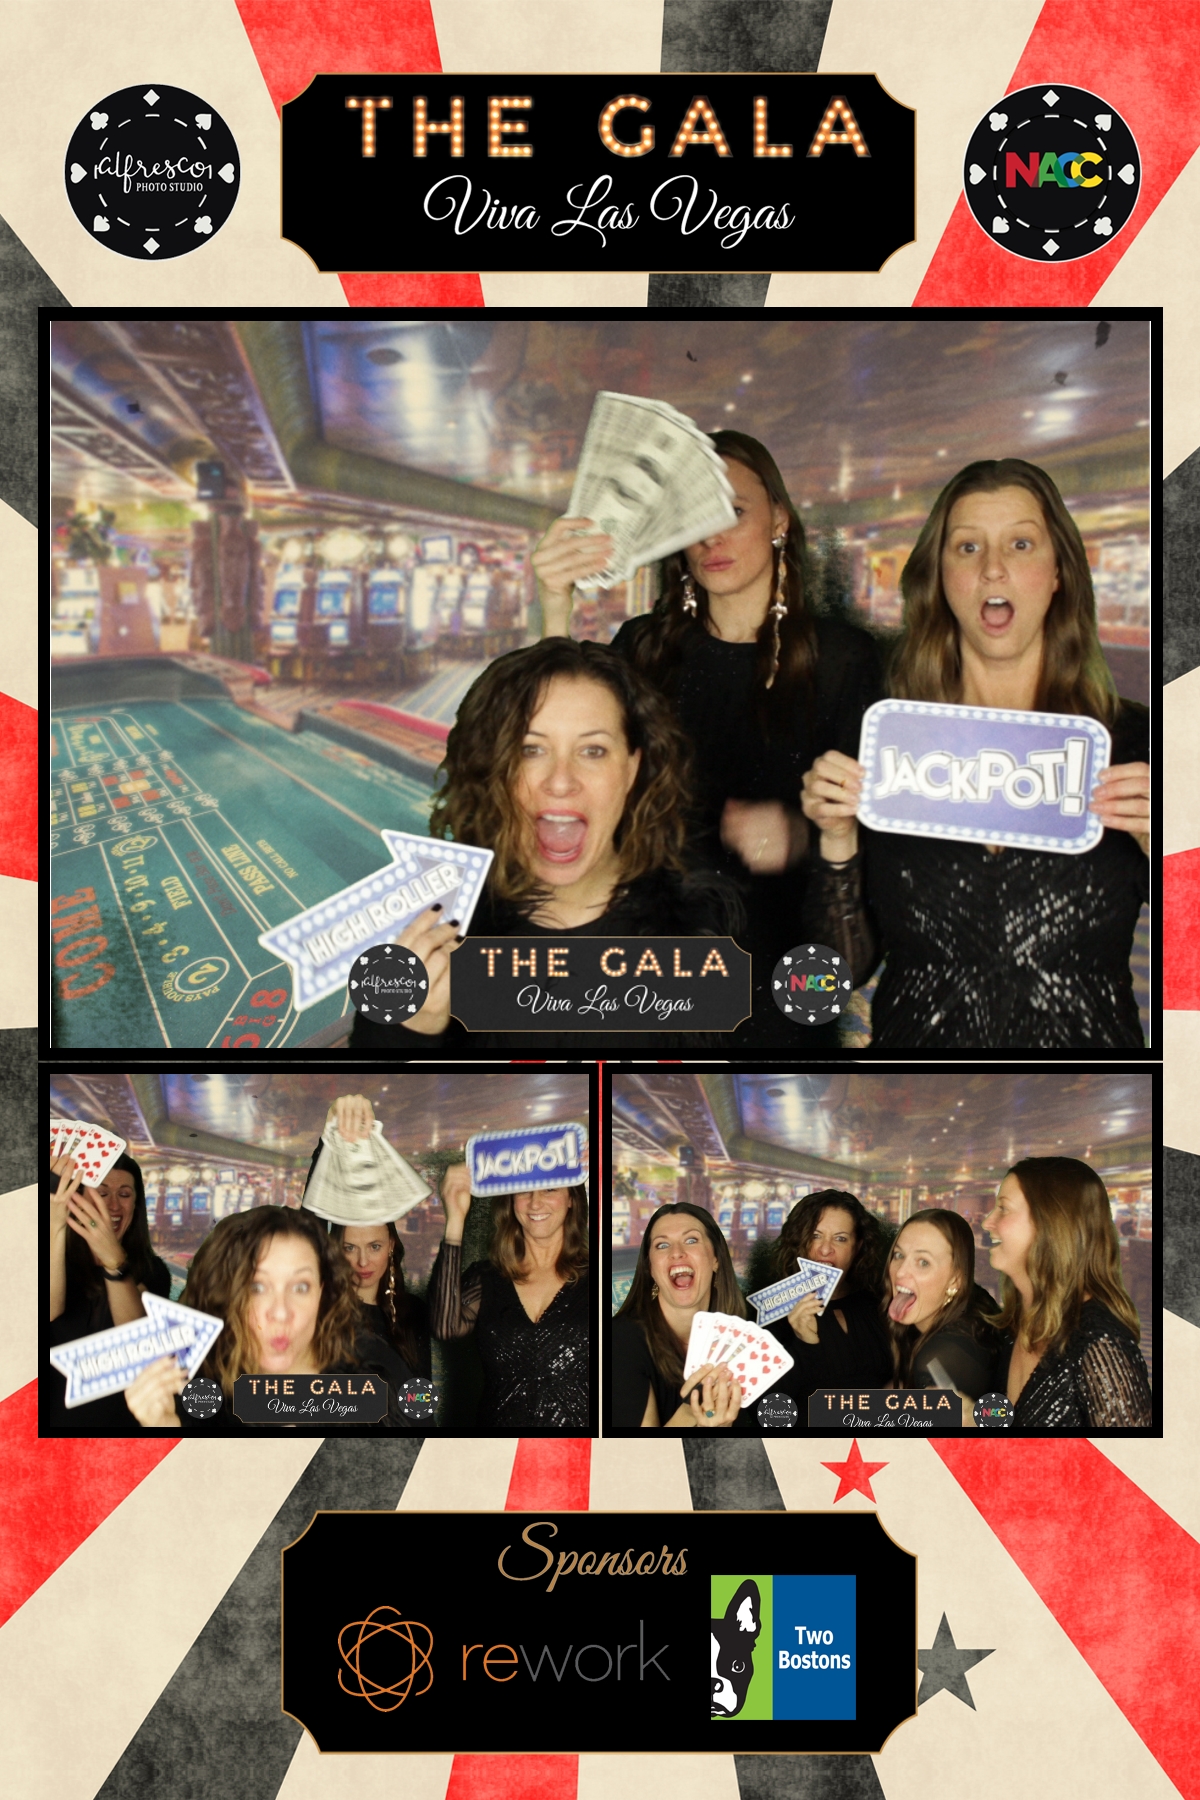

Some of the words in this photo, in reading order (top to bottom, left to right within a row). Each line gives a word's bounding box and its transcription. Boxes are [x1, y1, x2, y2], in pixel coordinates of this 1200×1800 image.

[875, 738, 1088, 816] JACKPOT!
[221, 843, 252, 868] LINE
[161, 876, 192, 910] FIELD
[238, 865, 275, 895] PASS
[304, 915, 371, 967] HIGH
[367, 863, 463, 930] ROLLER
[51, 886, 116, 1000] COME
[188, 963, 219, 984] 2
[185, 985, 220, 1002] PAYS
[250, 988, 288, 1008] 8
[476, 1131, 578, 1182] JACKPOT!
[763, 1291, 789, 1311] HIGH
[788, 1274, 828, 1298] ROLLER
